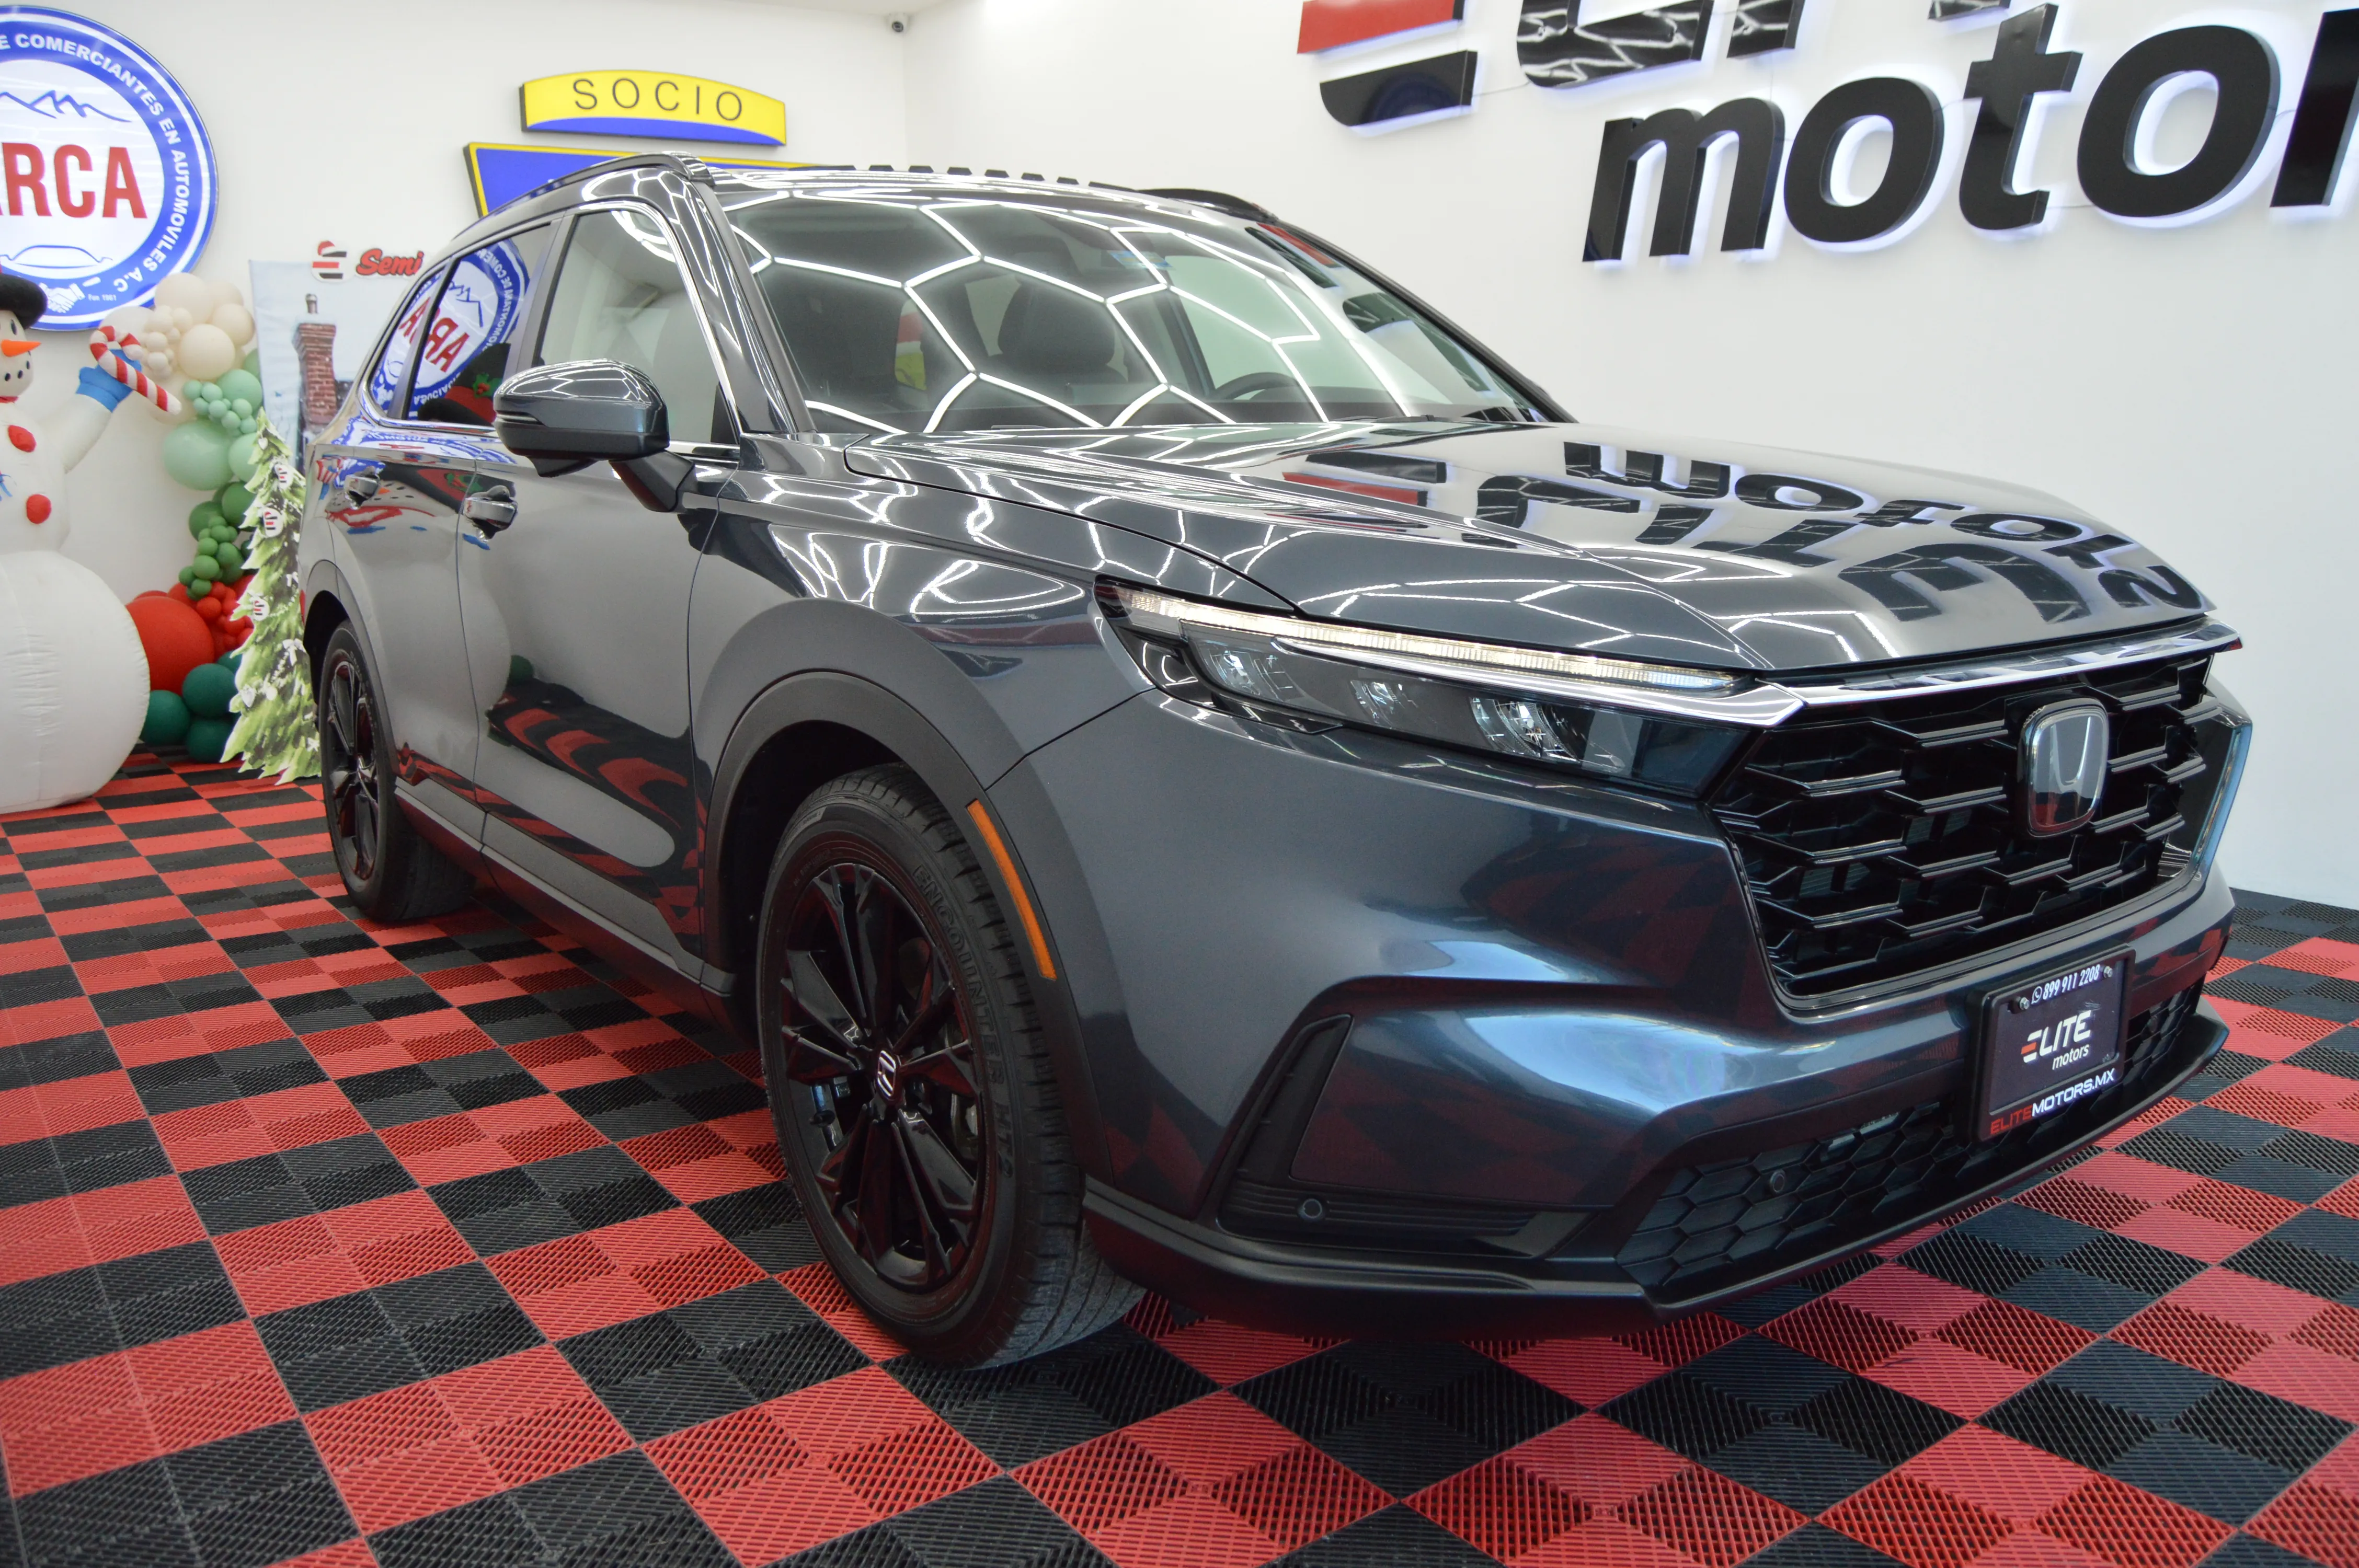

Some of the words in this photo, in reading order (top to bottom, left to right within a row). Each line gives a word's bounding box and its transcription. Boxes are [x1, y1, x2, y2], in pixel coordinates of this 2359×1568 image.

[15, 33, 164, 116] COMERCIANTES
[572, 77, 742, 121] SOCIO
[159, 118, 181, 145] EN
[0, 142, 148, 219] RCA
[143, 149, 190, 272] AUTOMOVILES
[2043, 978, 2060, 1000] 899
[2062, 973, 2078, 993] 911
[2079, 964, 2100, 987] 2208
[2021, 1009, 2091, 1063] ELITE
[2052, 1044, 2089, 1070] motors
[1990, 1068, 2115, 1135] ELITEMOTORS.MX
